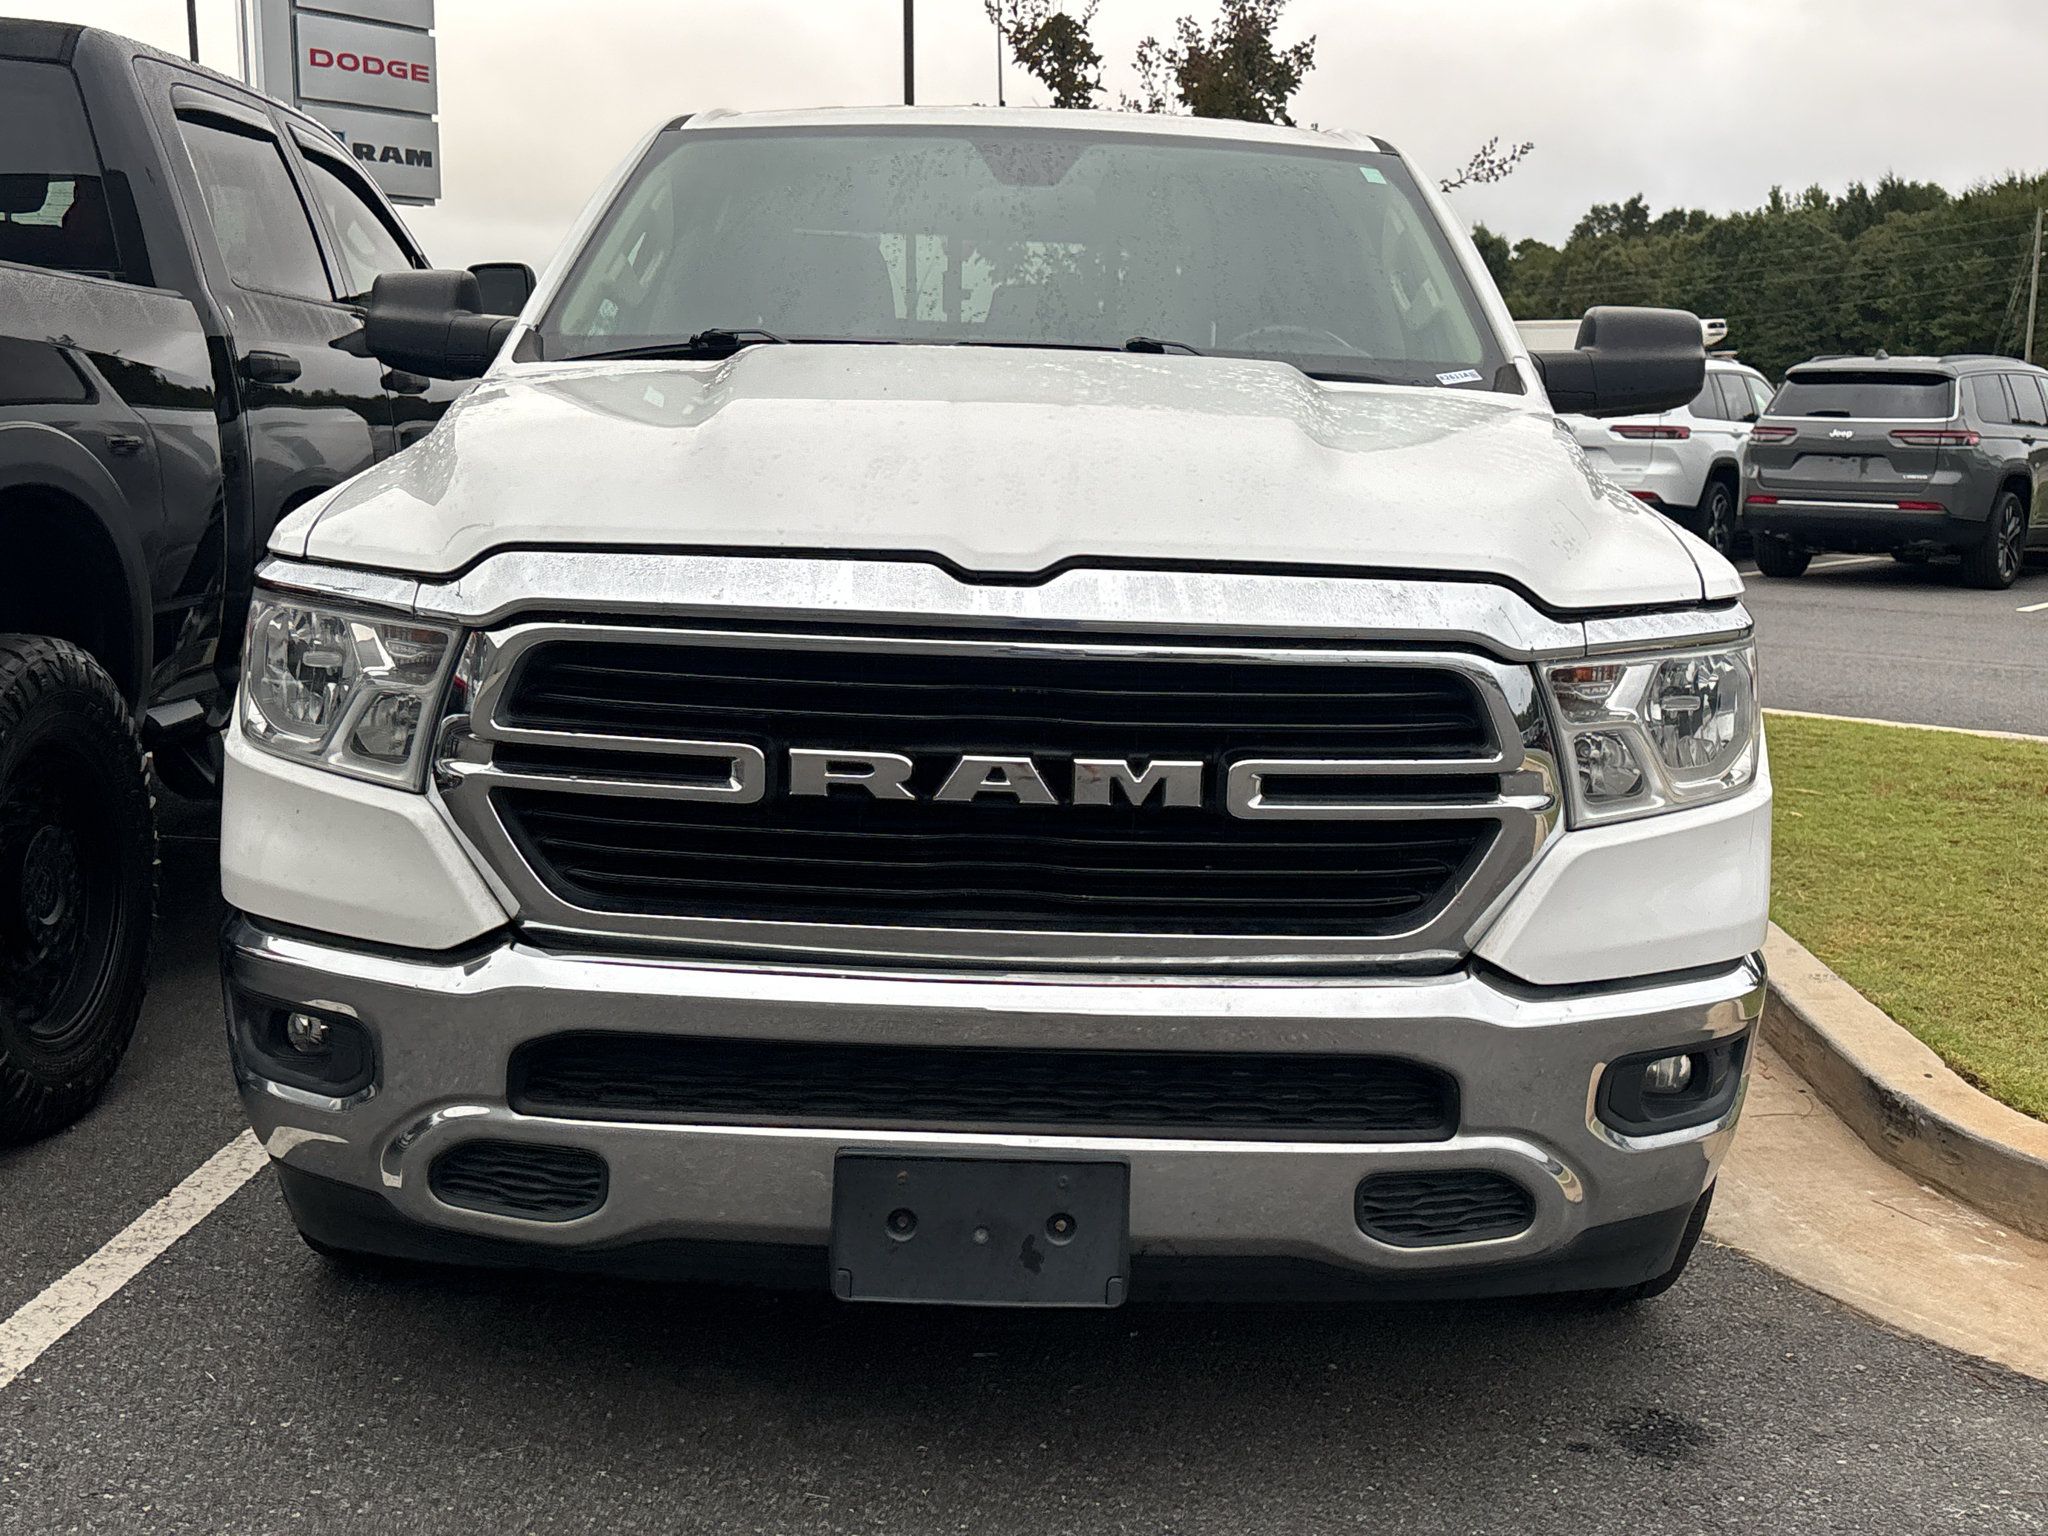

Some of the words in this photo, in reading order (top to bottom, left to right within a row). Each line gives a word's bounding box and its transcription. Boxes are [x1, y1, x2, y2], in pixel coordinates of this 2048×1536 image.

[309, 48, 430, 83] DODGE
[352, 142, 433, 168] RAM
[1829, 429, 1852, 438] Jeep
[789, 748, 1204, 807] RAM
